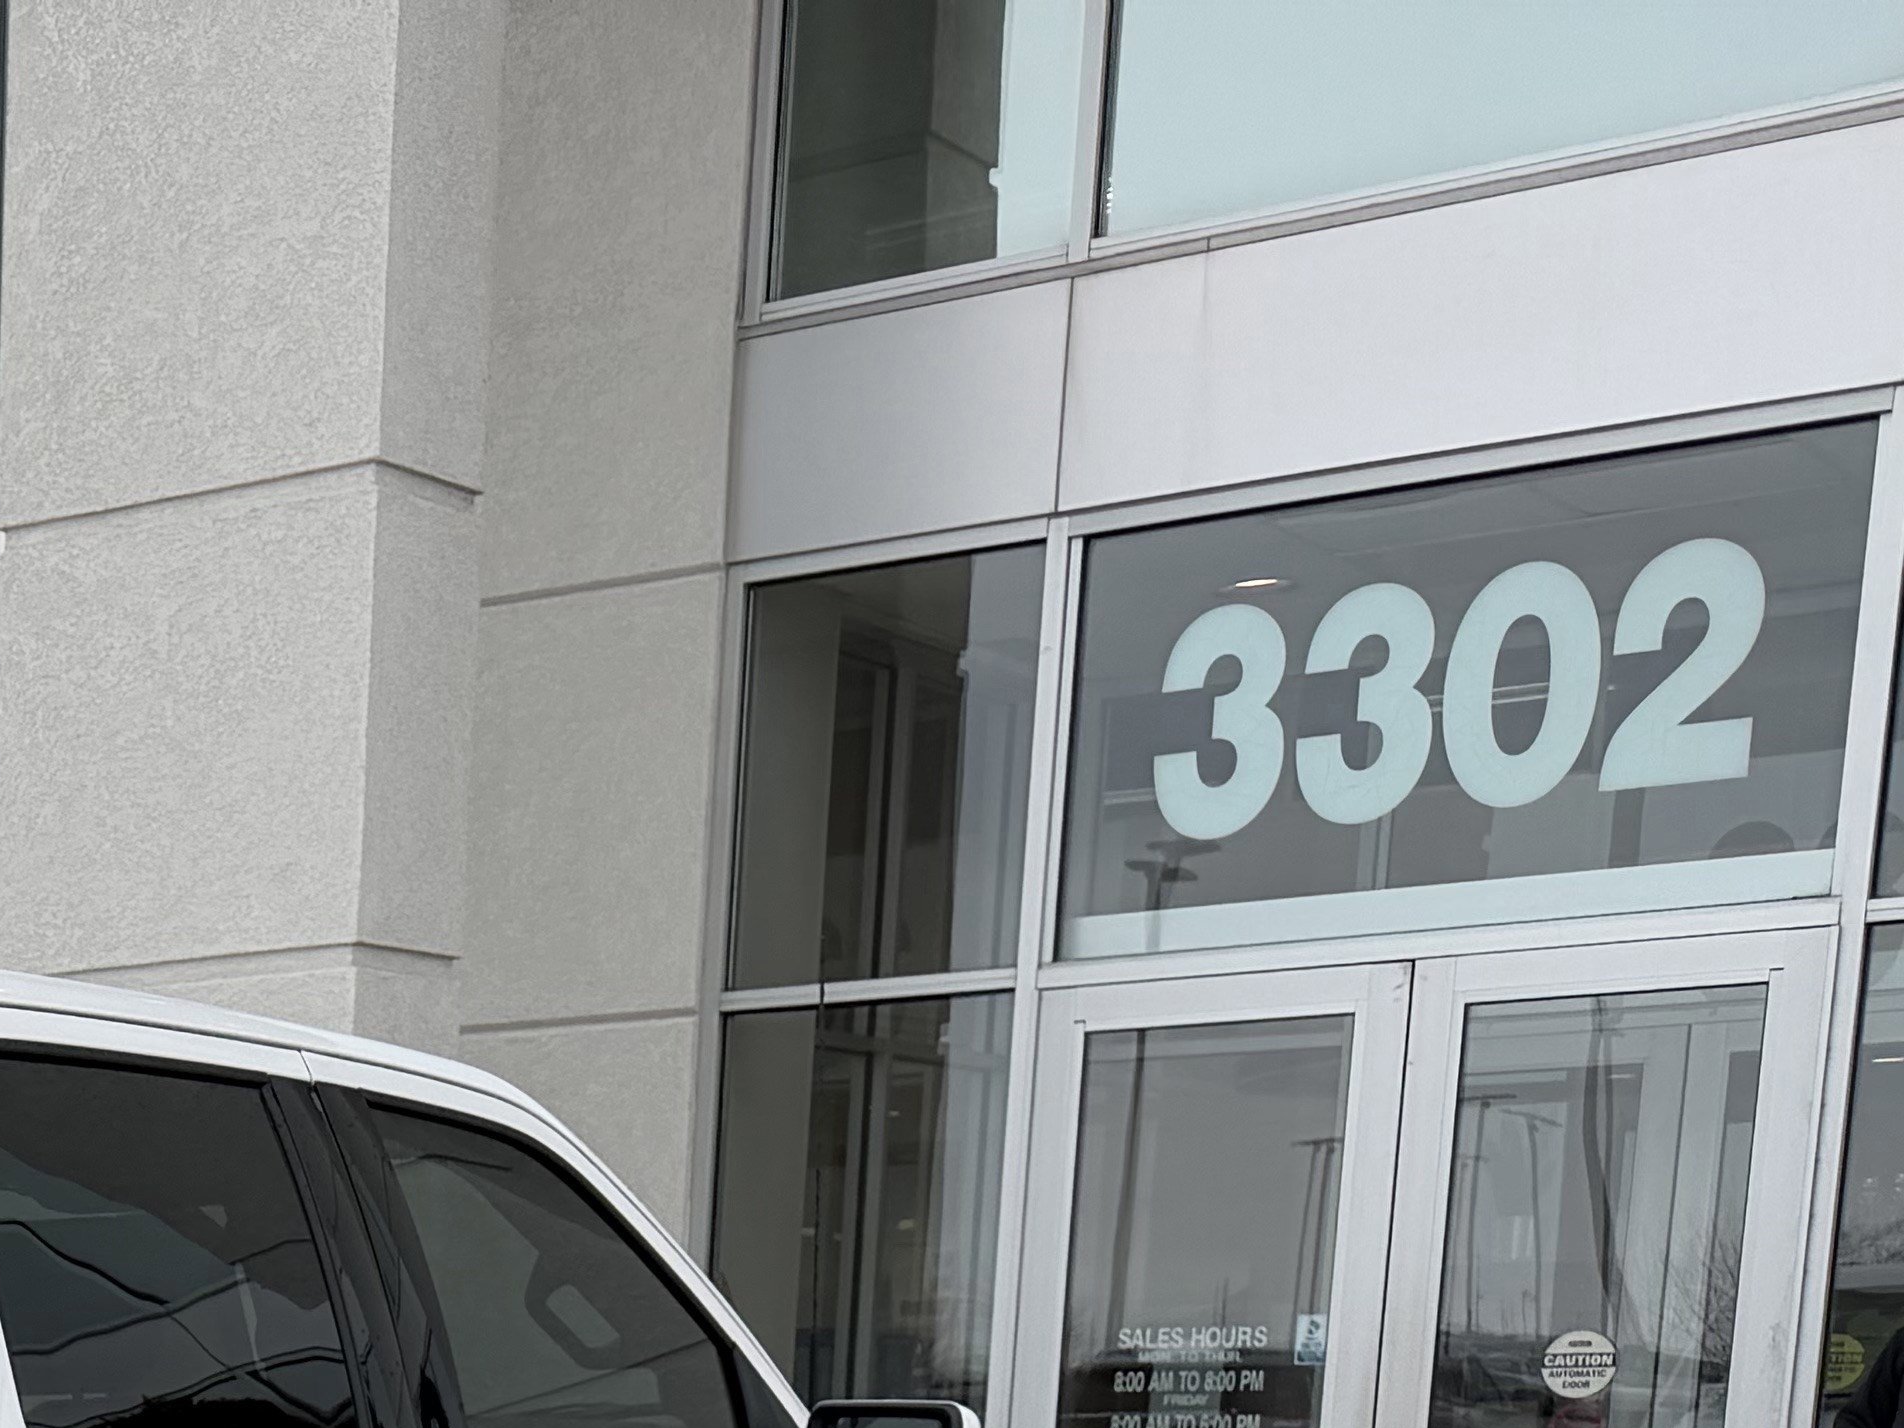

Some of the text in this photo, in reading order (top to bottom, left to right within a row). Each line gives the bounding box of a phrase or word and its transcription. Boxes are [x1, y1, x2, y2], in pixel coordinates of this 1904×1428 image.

[1153, 537, 1766, 841] 3302
[1118, 1326, 1268, 1350] SALES HOURS
[1543, 1354, 1613, 1366] CAUTION
[1829, 1353, 1863, 1362] TION
[1548, 1369, 1607, 1378] AUTOMATIC
[1113, 1369, 1265, 1392] 8:00 AM TO 8:00 PM
[1562, 1380, 1590, 1389] DOOR
[1162, 1393, 1210, 1406] FRIDAY
